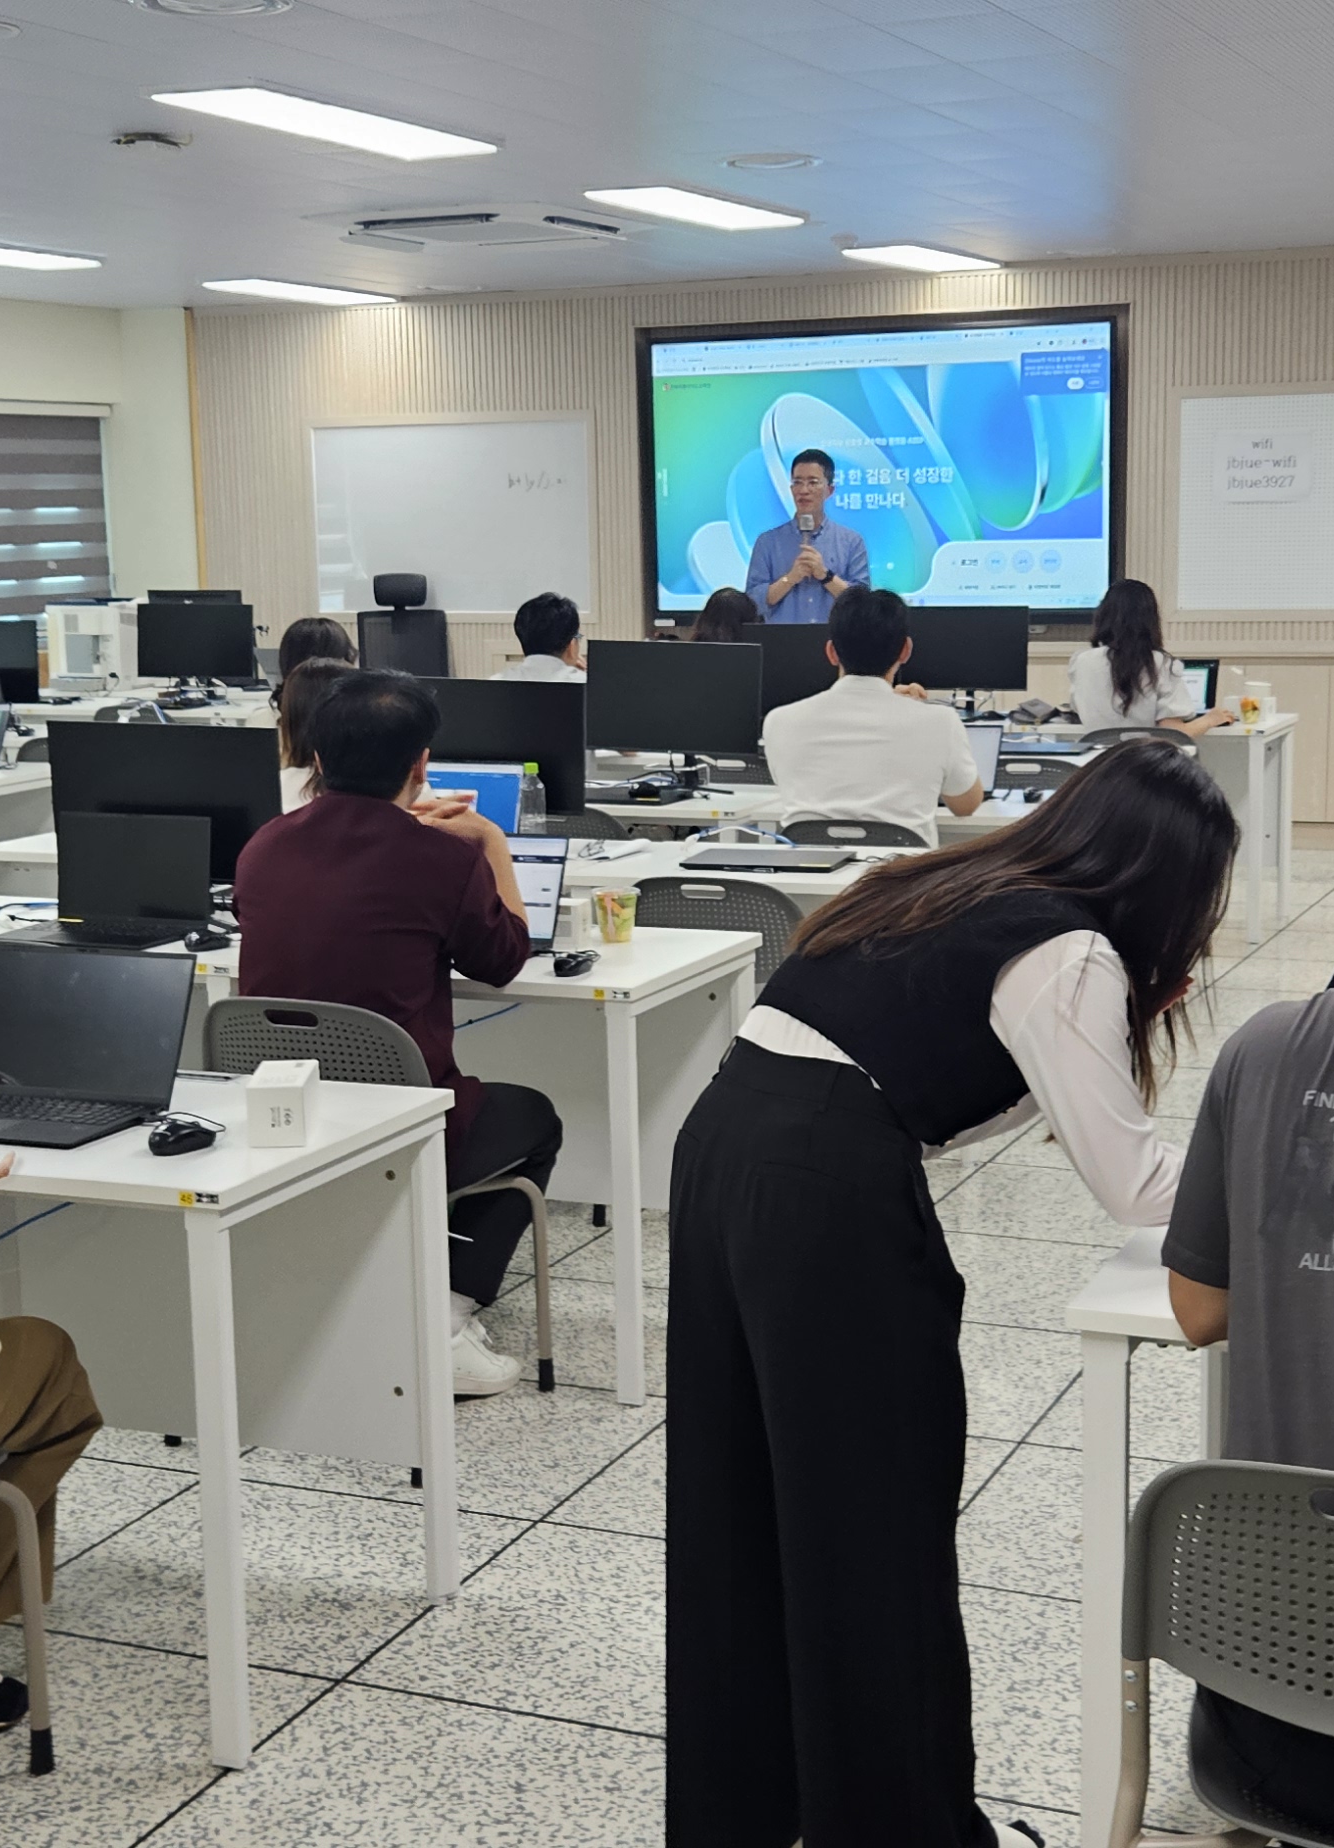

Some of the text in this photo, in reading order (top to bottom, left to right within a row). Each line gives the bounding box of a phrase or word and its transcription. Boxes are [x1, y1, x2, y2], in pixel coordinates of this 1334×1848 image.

[1252, 438, 1273, 450] wifi
[848, 469, 862, 486] 한
[866, 468, 891, 485] 걸음
[896, 467, 910, 484] 더
[913, 467, 954, 484] 성장한
[835, 493, 862, 510] 나를
